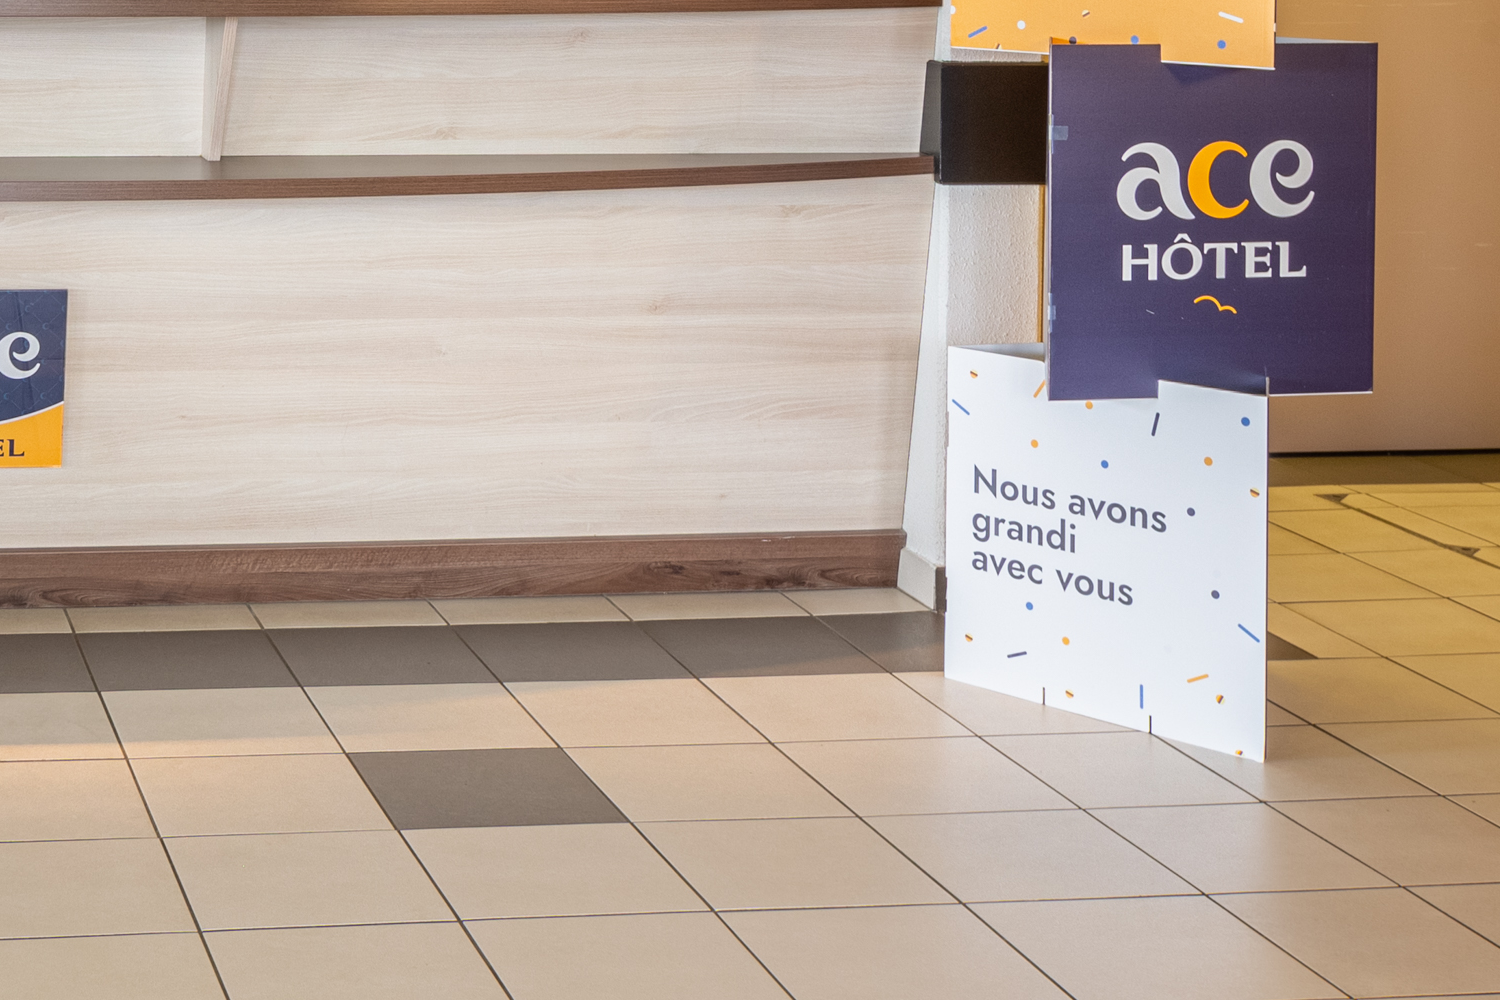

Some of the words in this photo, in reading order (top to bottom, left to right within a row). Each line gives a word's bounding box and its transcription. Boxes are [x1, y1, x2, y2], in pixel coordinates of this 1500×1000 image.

[1116, 139, 1315, 221] ace
[1121, 233, 1307, 282] HÔTEL
[973, 463, 1056, 511] Nous
[1068, 493, 1168, 534] avons
[972, 511, 1077, 555] grandi
[971, 550, 1044, 586] avec
[1055, 568, 1134, 607] vous
